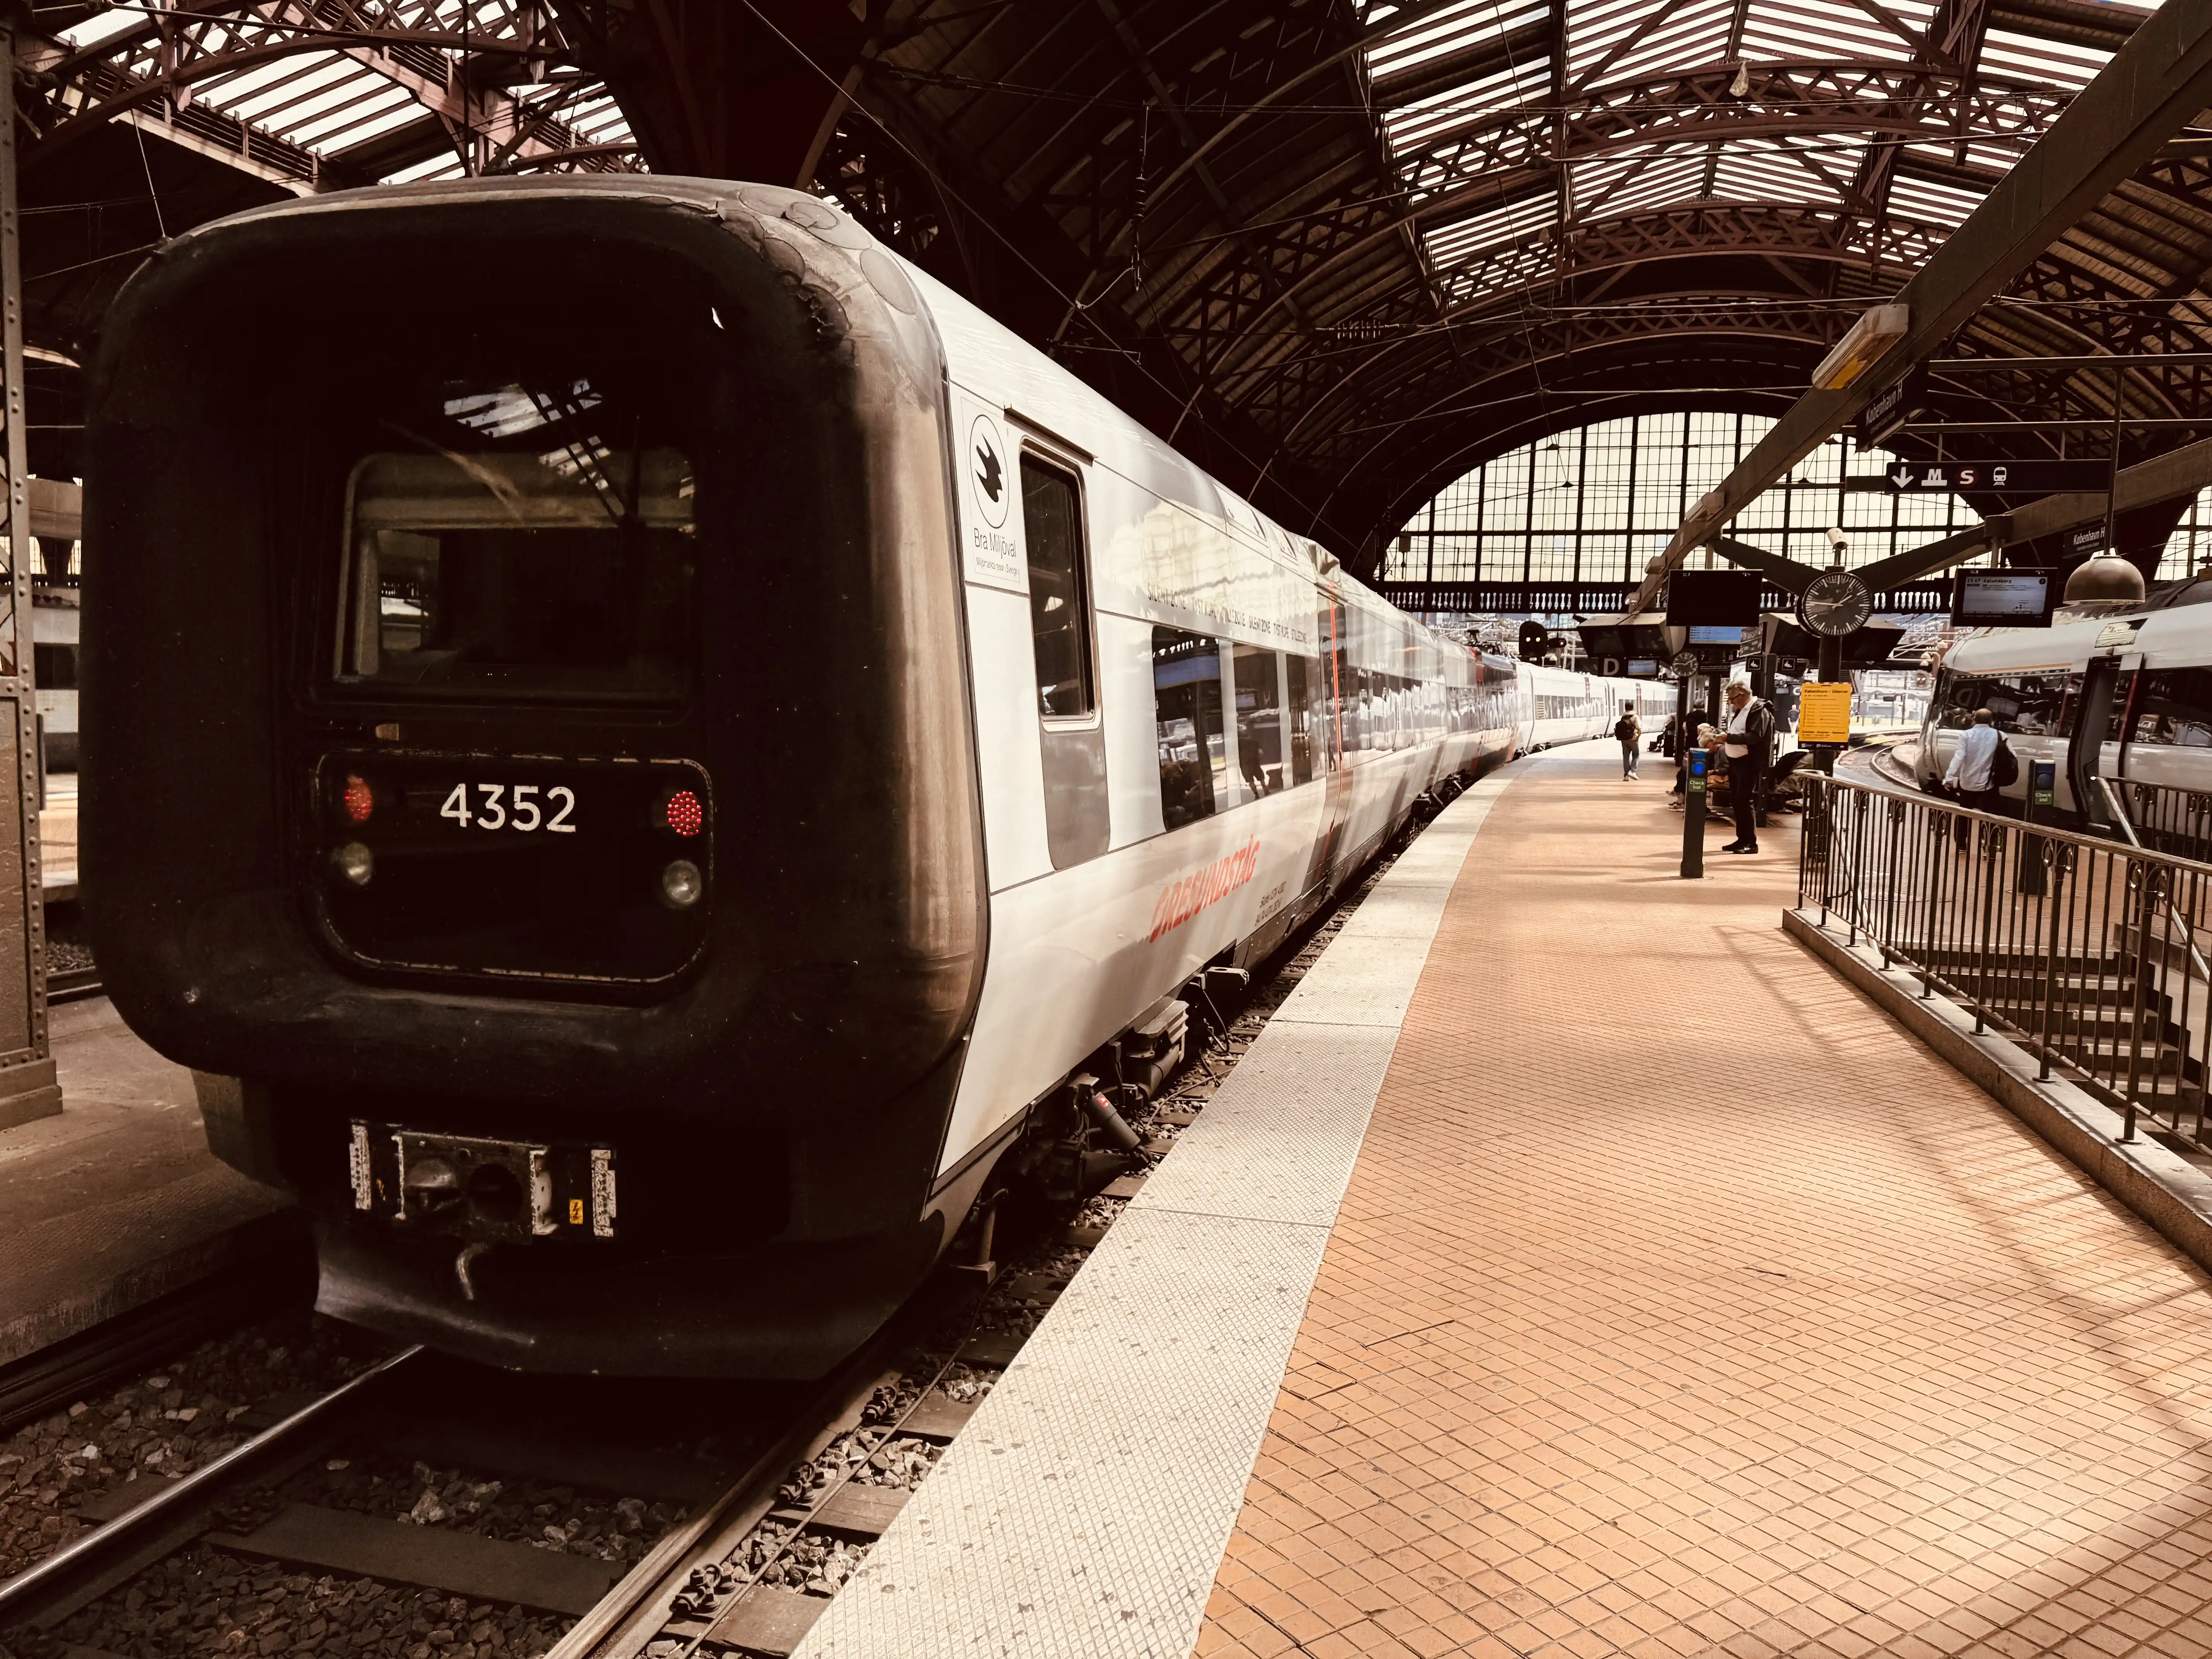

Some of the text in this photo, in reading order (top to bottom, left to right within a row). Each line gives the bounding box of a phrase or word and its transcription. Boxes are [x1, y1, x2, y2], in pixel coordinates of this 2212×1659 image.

[1898, 380, 1903, 401] H
[1960, 470, 1973, 484] S
[2100, 526, 2105, 538] H
[974, 528, 1016, 559] Bra Miljöval
[1603, 658, 1620, 676] D
[440, 783, 576, 833] 4352
